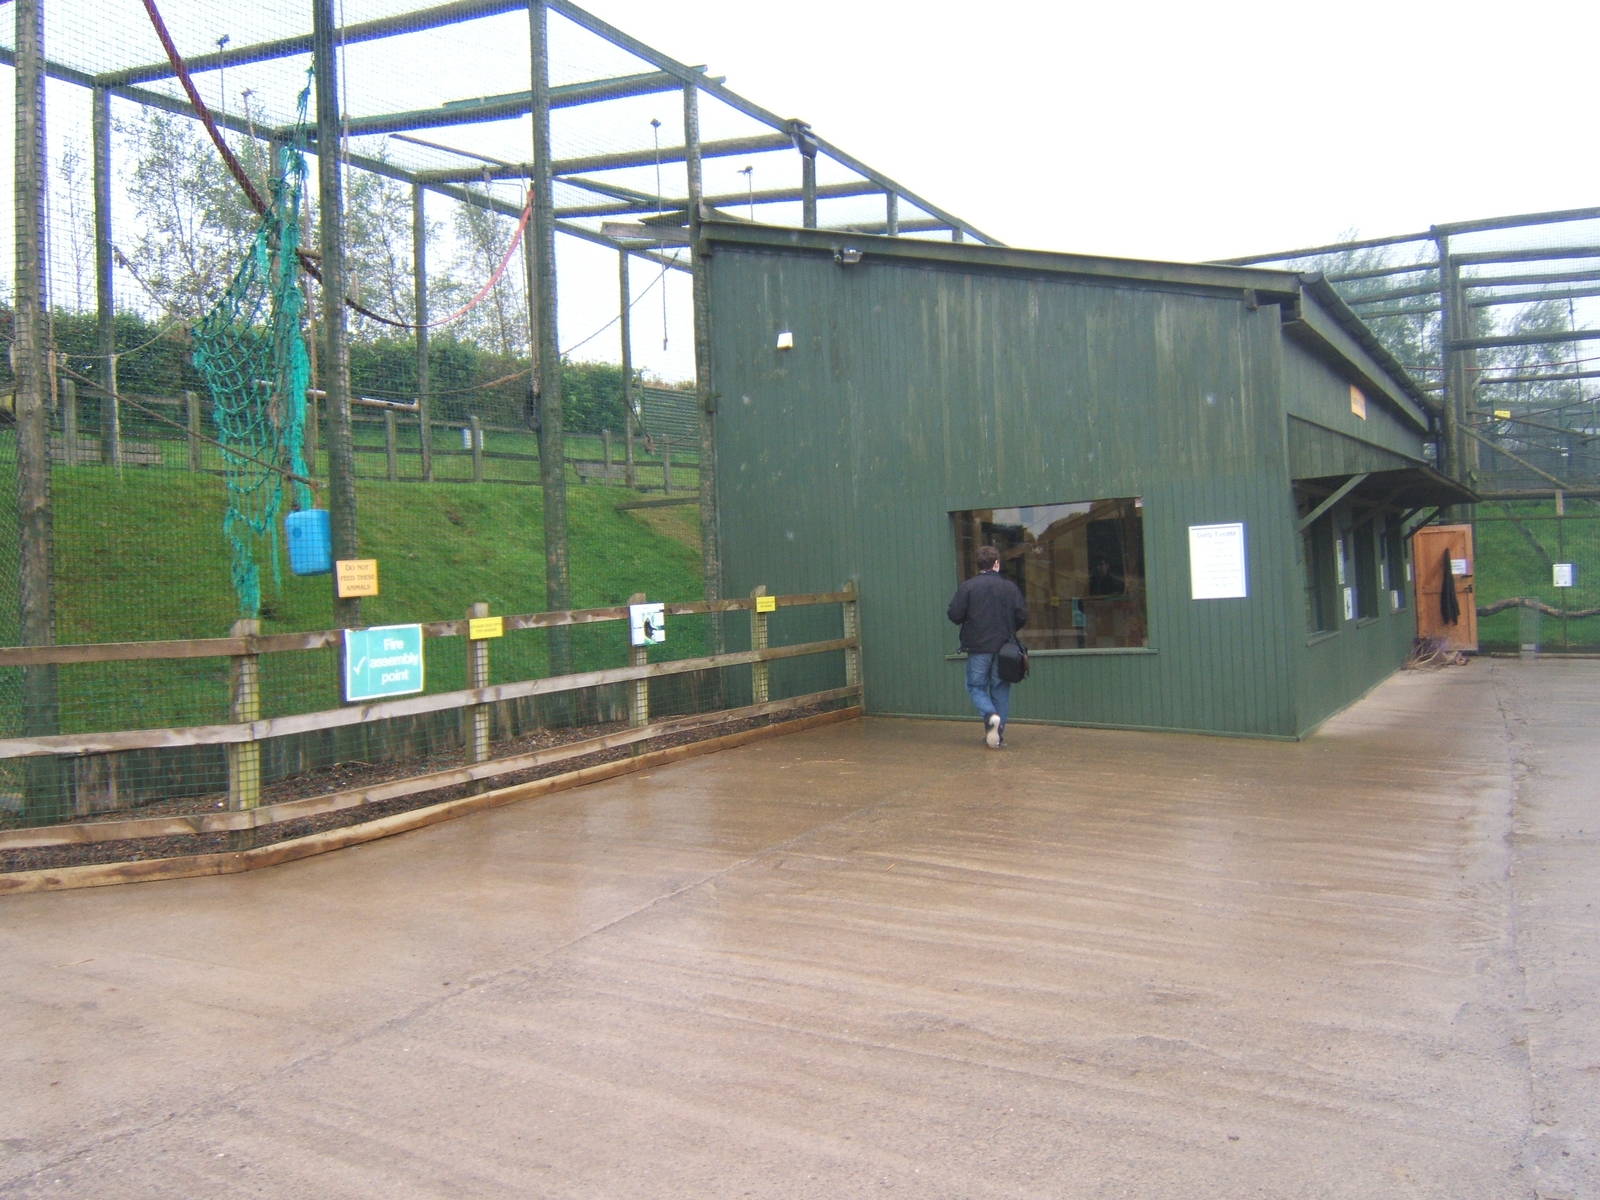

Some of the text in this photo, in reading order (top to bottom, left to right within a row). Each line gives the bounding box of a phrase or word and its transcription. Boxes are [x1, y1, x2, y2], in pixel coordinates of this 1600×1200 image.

[383, 638, 404, 651] Fire
[369, 653, 419, 668] assembly
[381, 669, 409, 685] point
